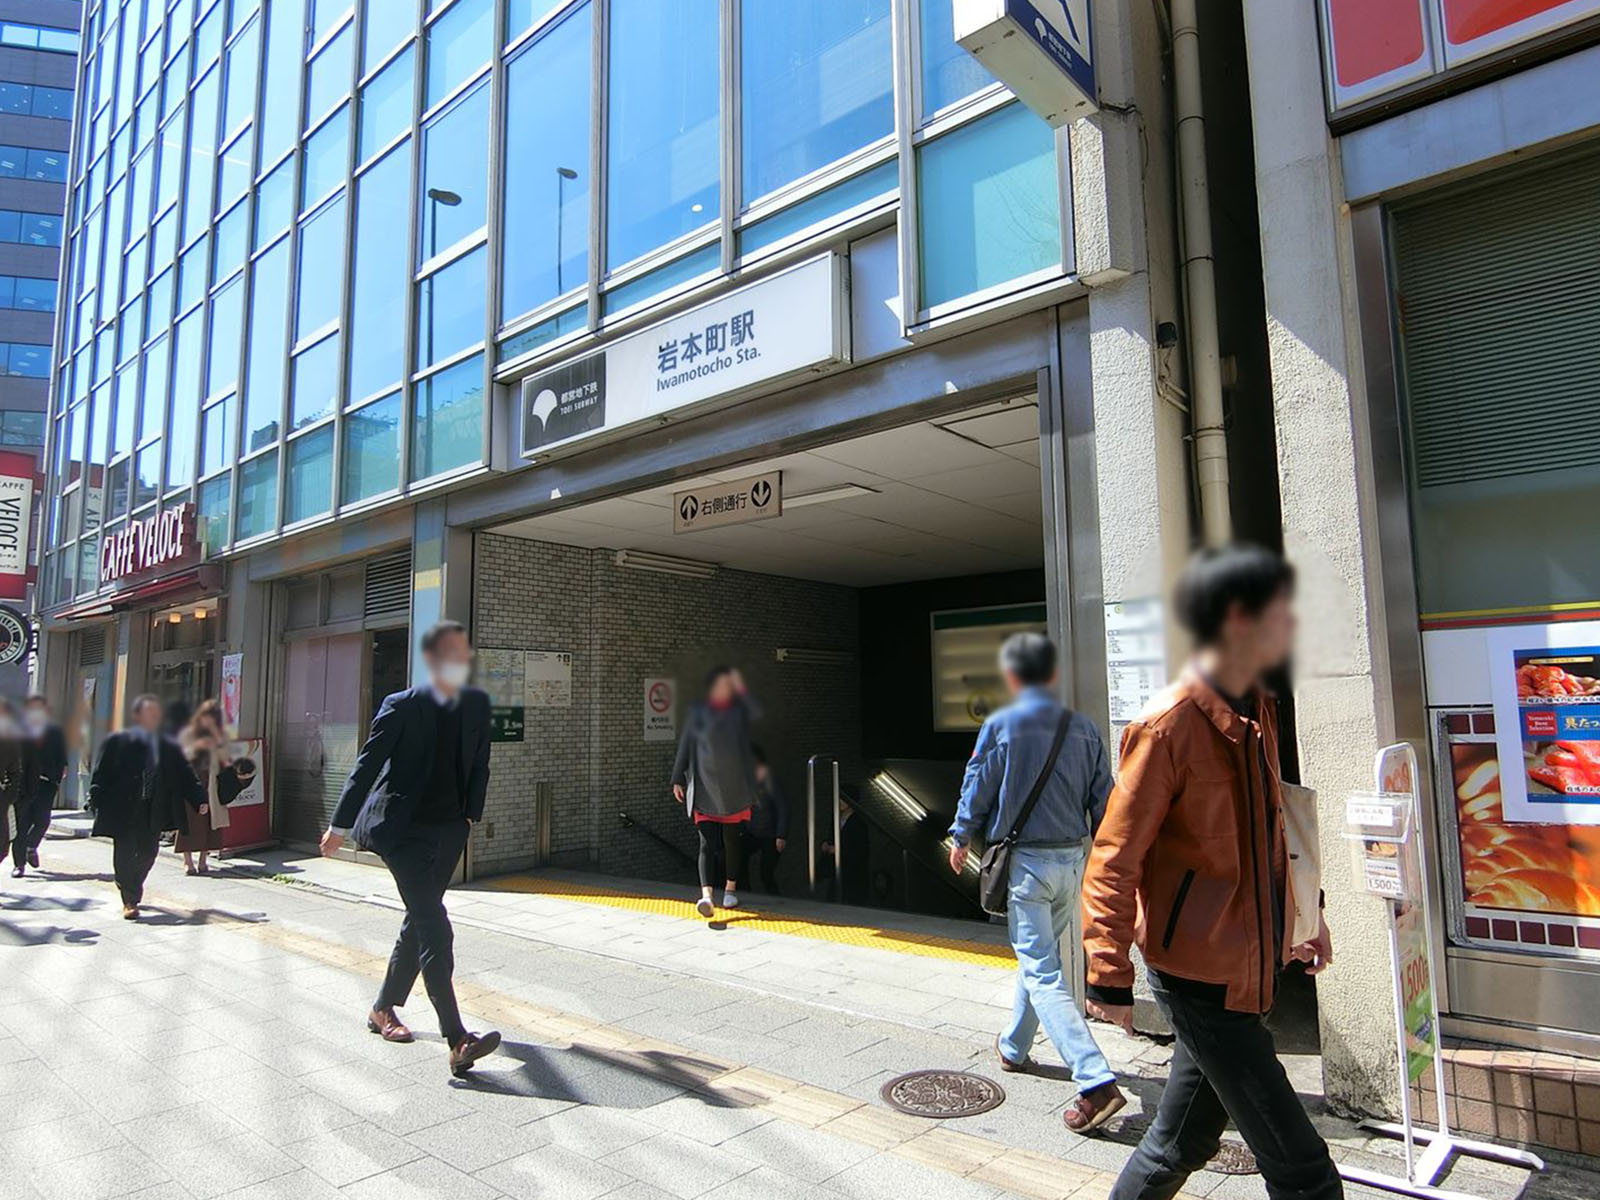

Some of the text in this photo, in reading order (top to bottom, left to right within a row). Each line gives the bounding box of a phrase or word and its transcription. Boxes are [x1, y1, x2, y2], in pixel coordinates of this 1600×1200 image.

[658, 309, 755, 374] 岩本町駅
[656, 347, 762, 392] Iwamotocho Sta.
[701, 493, 748, 516] 右側通行
[138, 502, 186, 570] VELOCE
[1565, 716, 1600, 729] 具たっ
